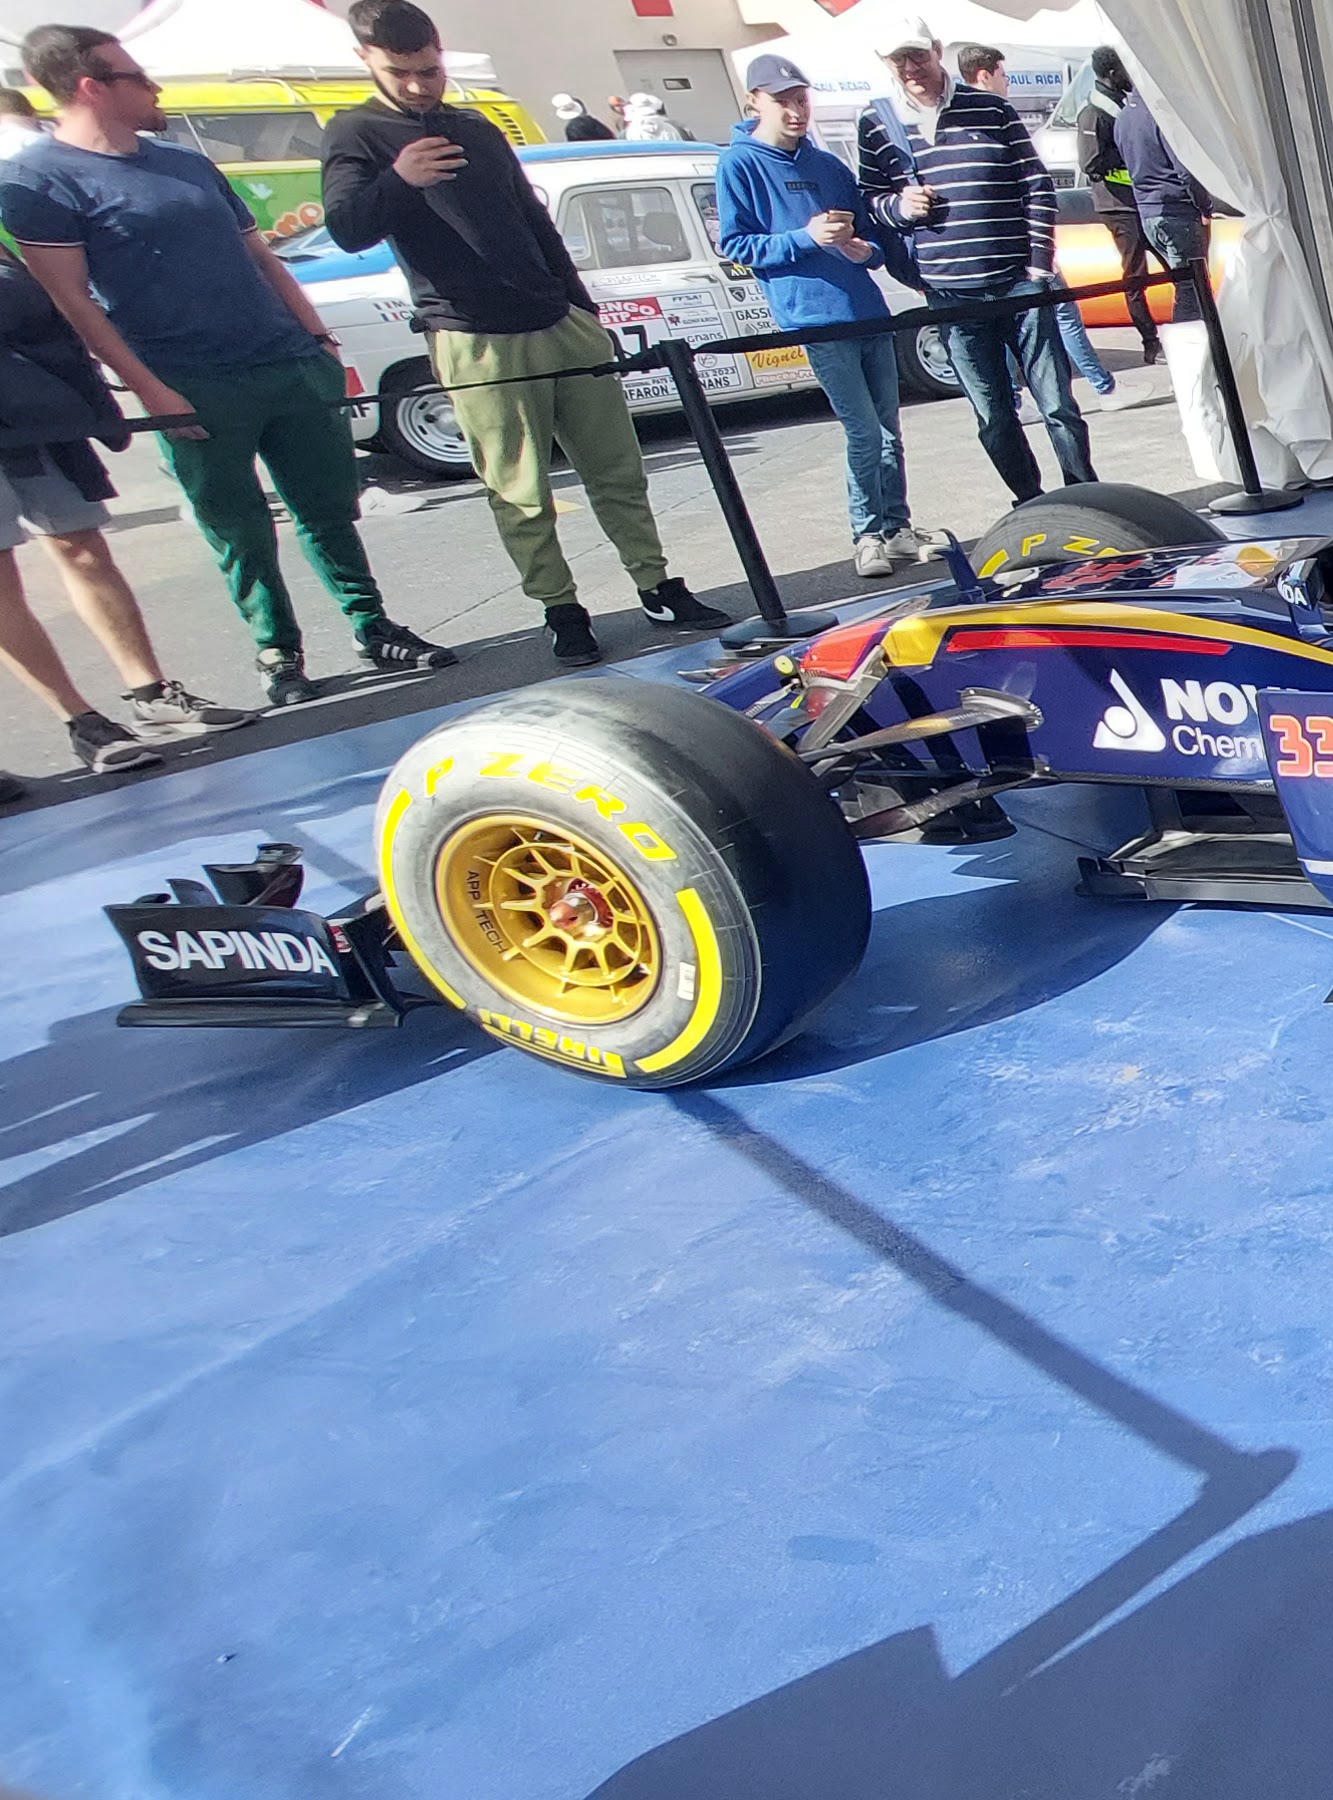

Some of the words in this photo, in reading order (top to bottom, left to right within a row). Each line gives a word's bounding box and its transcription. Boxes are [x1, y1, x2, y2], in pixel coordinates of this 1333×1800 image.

[1035, 74, 1063, 85] RICA
[685, 332, 724, 344] gnans
[699, 376, 730, 390] NANS
[1021, 533, 1048, 558] P
[1171, 725, 1265, 761] Chem
[423, 756, 456, 798] P
[479, 751, 679, 862] ZERO
[464, 869, 481, 902] APP
[475, 909, 508, 954] TECH
[137, 930, 339, 978] SAPINDA
[477, 1007, 628, 1079] PIRELLI
